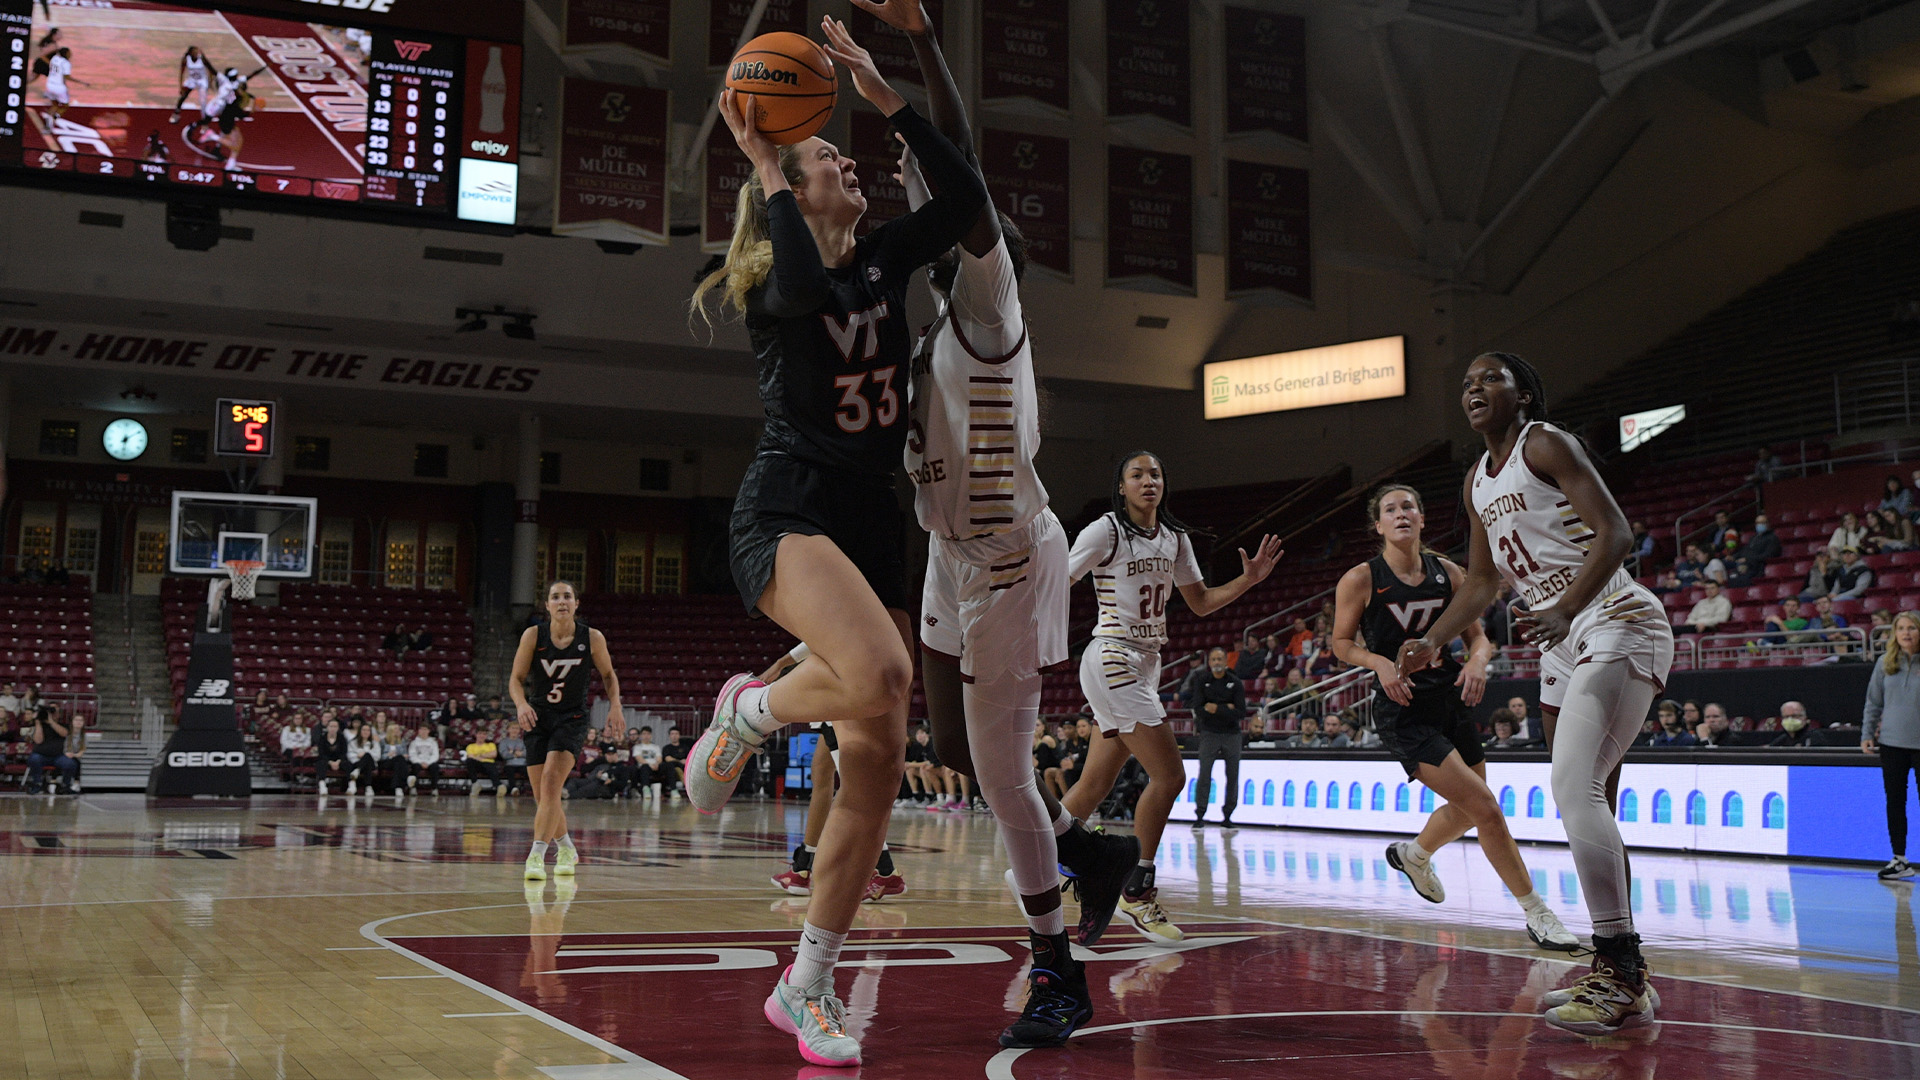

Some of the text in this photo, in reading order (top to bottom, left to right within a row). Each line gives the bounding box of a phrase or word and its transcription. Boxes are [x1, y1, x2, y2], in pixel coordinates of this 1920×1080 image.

[11, 37, 24, 53] 0
[393, 39, 432, 61] VT
[11, 55, 24, 70] 2
[732, 60, 799, 87] Wilson
[8, 74, 22, 89] 0
[7, 92, 20, 107] 0
[380, 83, 447, 105] 5 0 0
[5, 109, 19, 124] 0
[373, 99, 446, 121] 13 0 0
[370, 117, 446, 138] 22 0 3
[368, 134, 445, 156] 23 1 0
[471, 139, 510, 157] enjoy
[602, 144, 627, 160] JOE
[99, 161, 114, 174] 2
[367, 150, 444, 172] 33 0 4
[579, 156, 648, 178] MULLEN
[178, 170, 215, 184] 5:47
[276, 178, 290, 192] 7
[461, 190, 512, 204] EMPOWER
[578, 192, 648, 210] 1975-79
[1006, 192, 1046, 218] 16
[819, 300, 891, 364] VT
[74, 332, 208, 368] HOME
[213, 343, 276, 373] OF
[286, 349, 369, 380] THE
[380, 356, 541, 393] EAGLES
[1234, 364, 1396, 398] Mass General Brigham
[833, 364, 900, 434] 33
[232, 404, 269, 424] 5:46
[244, 422, 264, 452] 5
[1498, 528, 1541, 581] 21
[1139, 583, 1165, 619] 20
[1384, 597, 1446, 633] VT
[540, 658, 584, 680] VT
[546, 682, 566, 704] 5
[168, 751, 246, 768] GEICO
